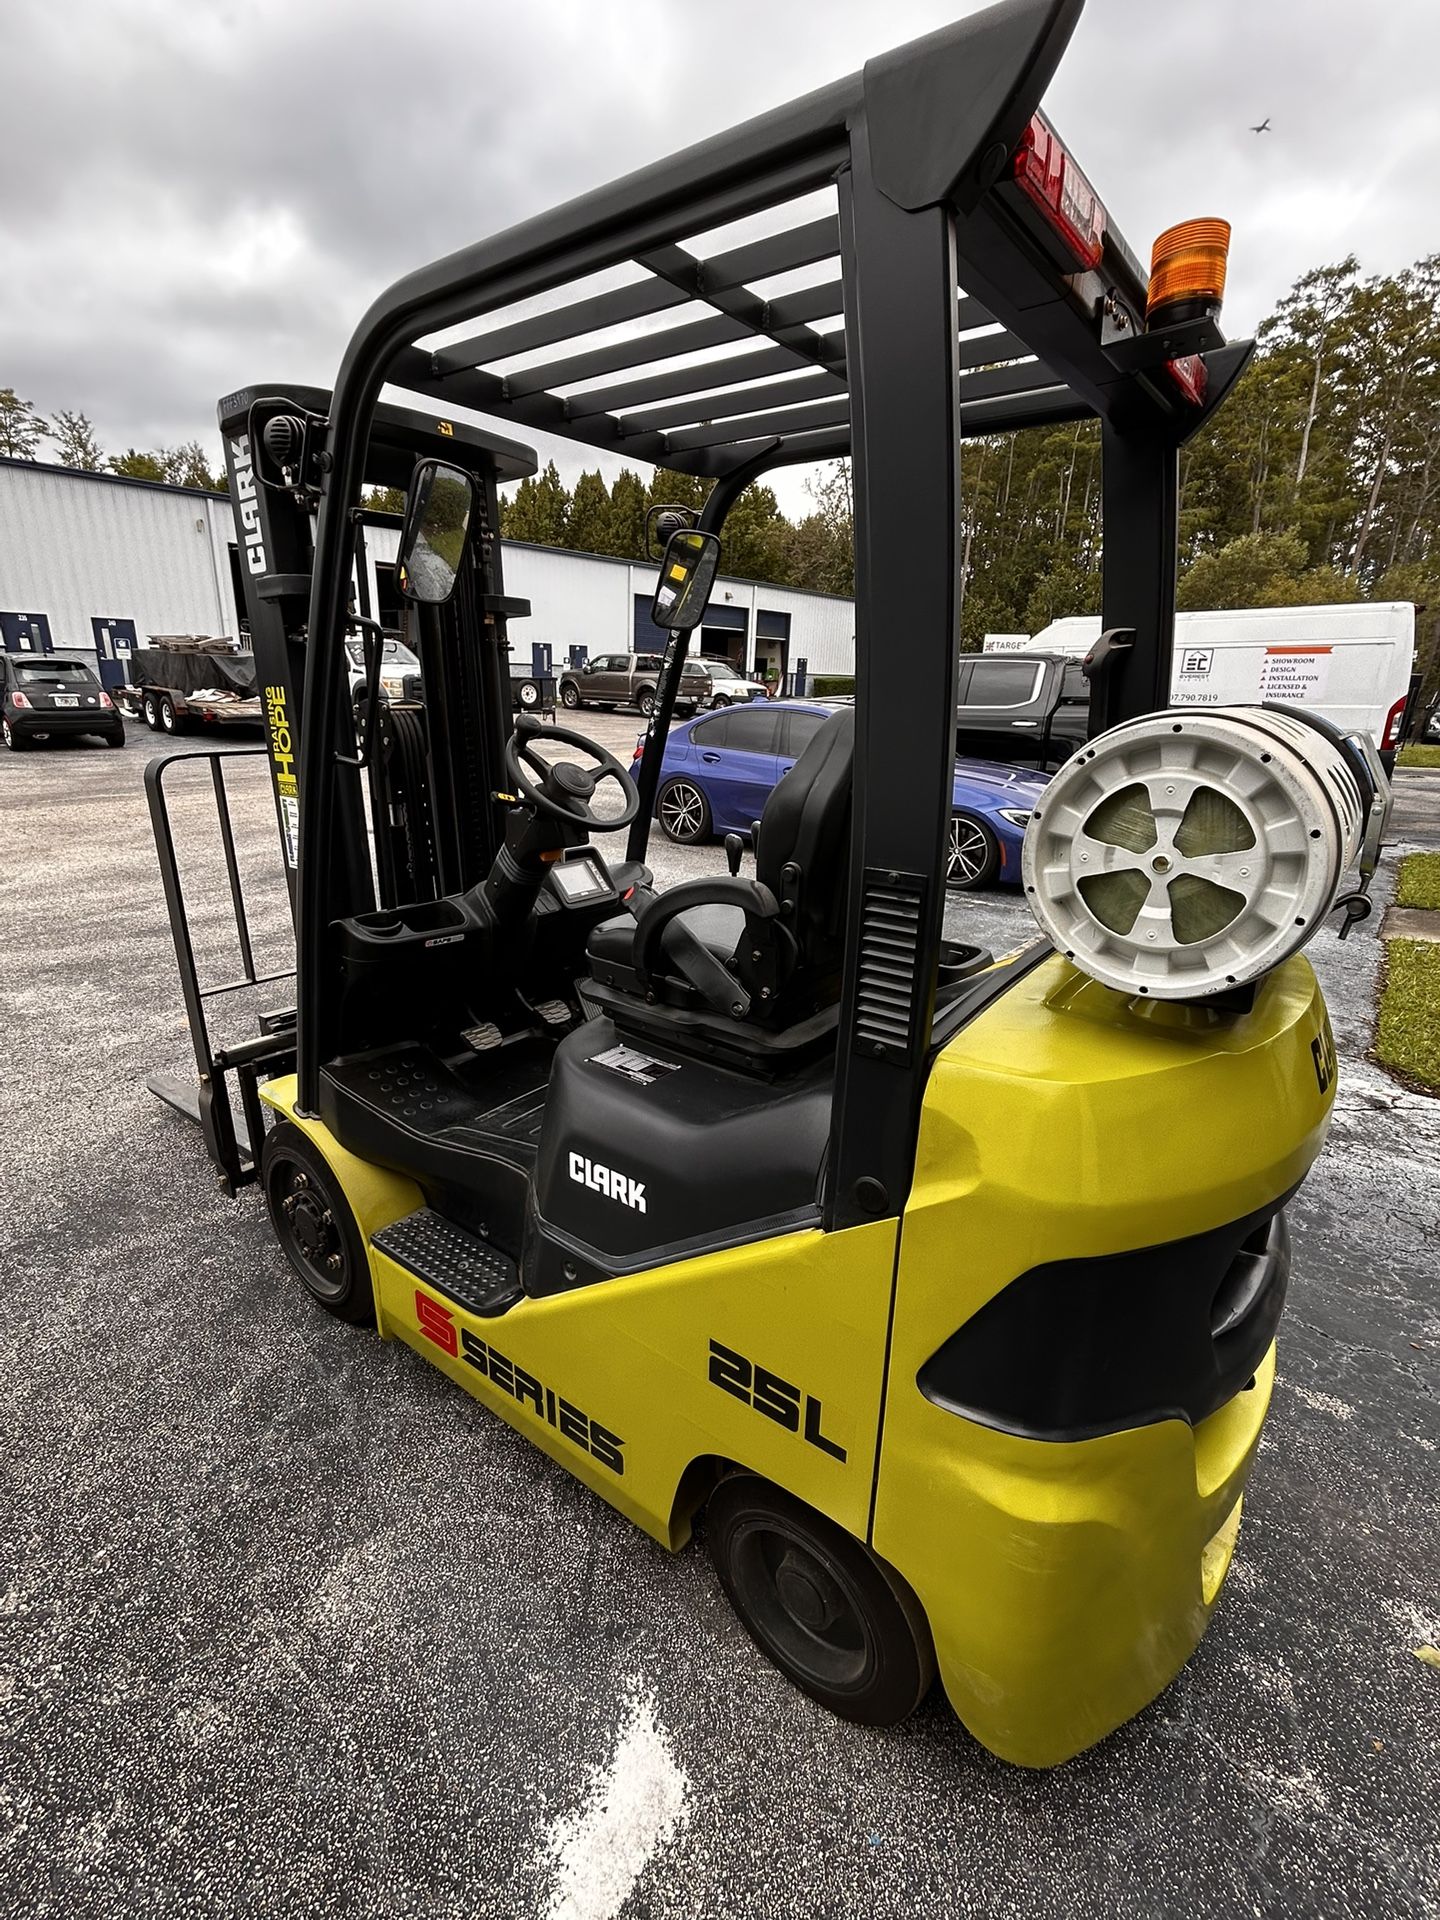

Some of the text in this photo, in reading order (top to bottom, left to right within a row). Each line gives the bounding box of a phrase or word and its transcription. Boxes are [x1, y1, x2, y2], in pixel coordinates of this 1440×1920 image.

[231, 434, 266, 575] CLARK
[265, 687, 280, 752] RAISING
[272, 686, 297, 782] HOPE
[569, 1151, 647, 1214] CLARK
[415, 1289, 626, 1476] S SERIES
[708, 1337, 847, 1465] 25L
